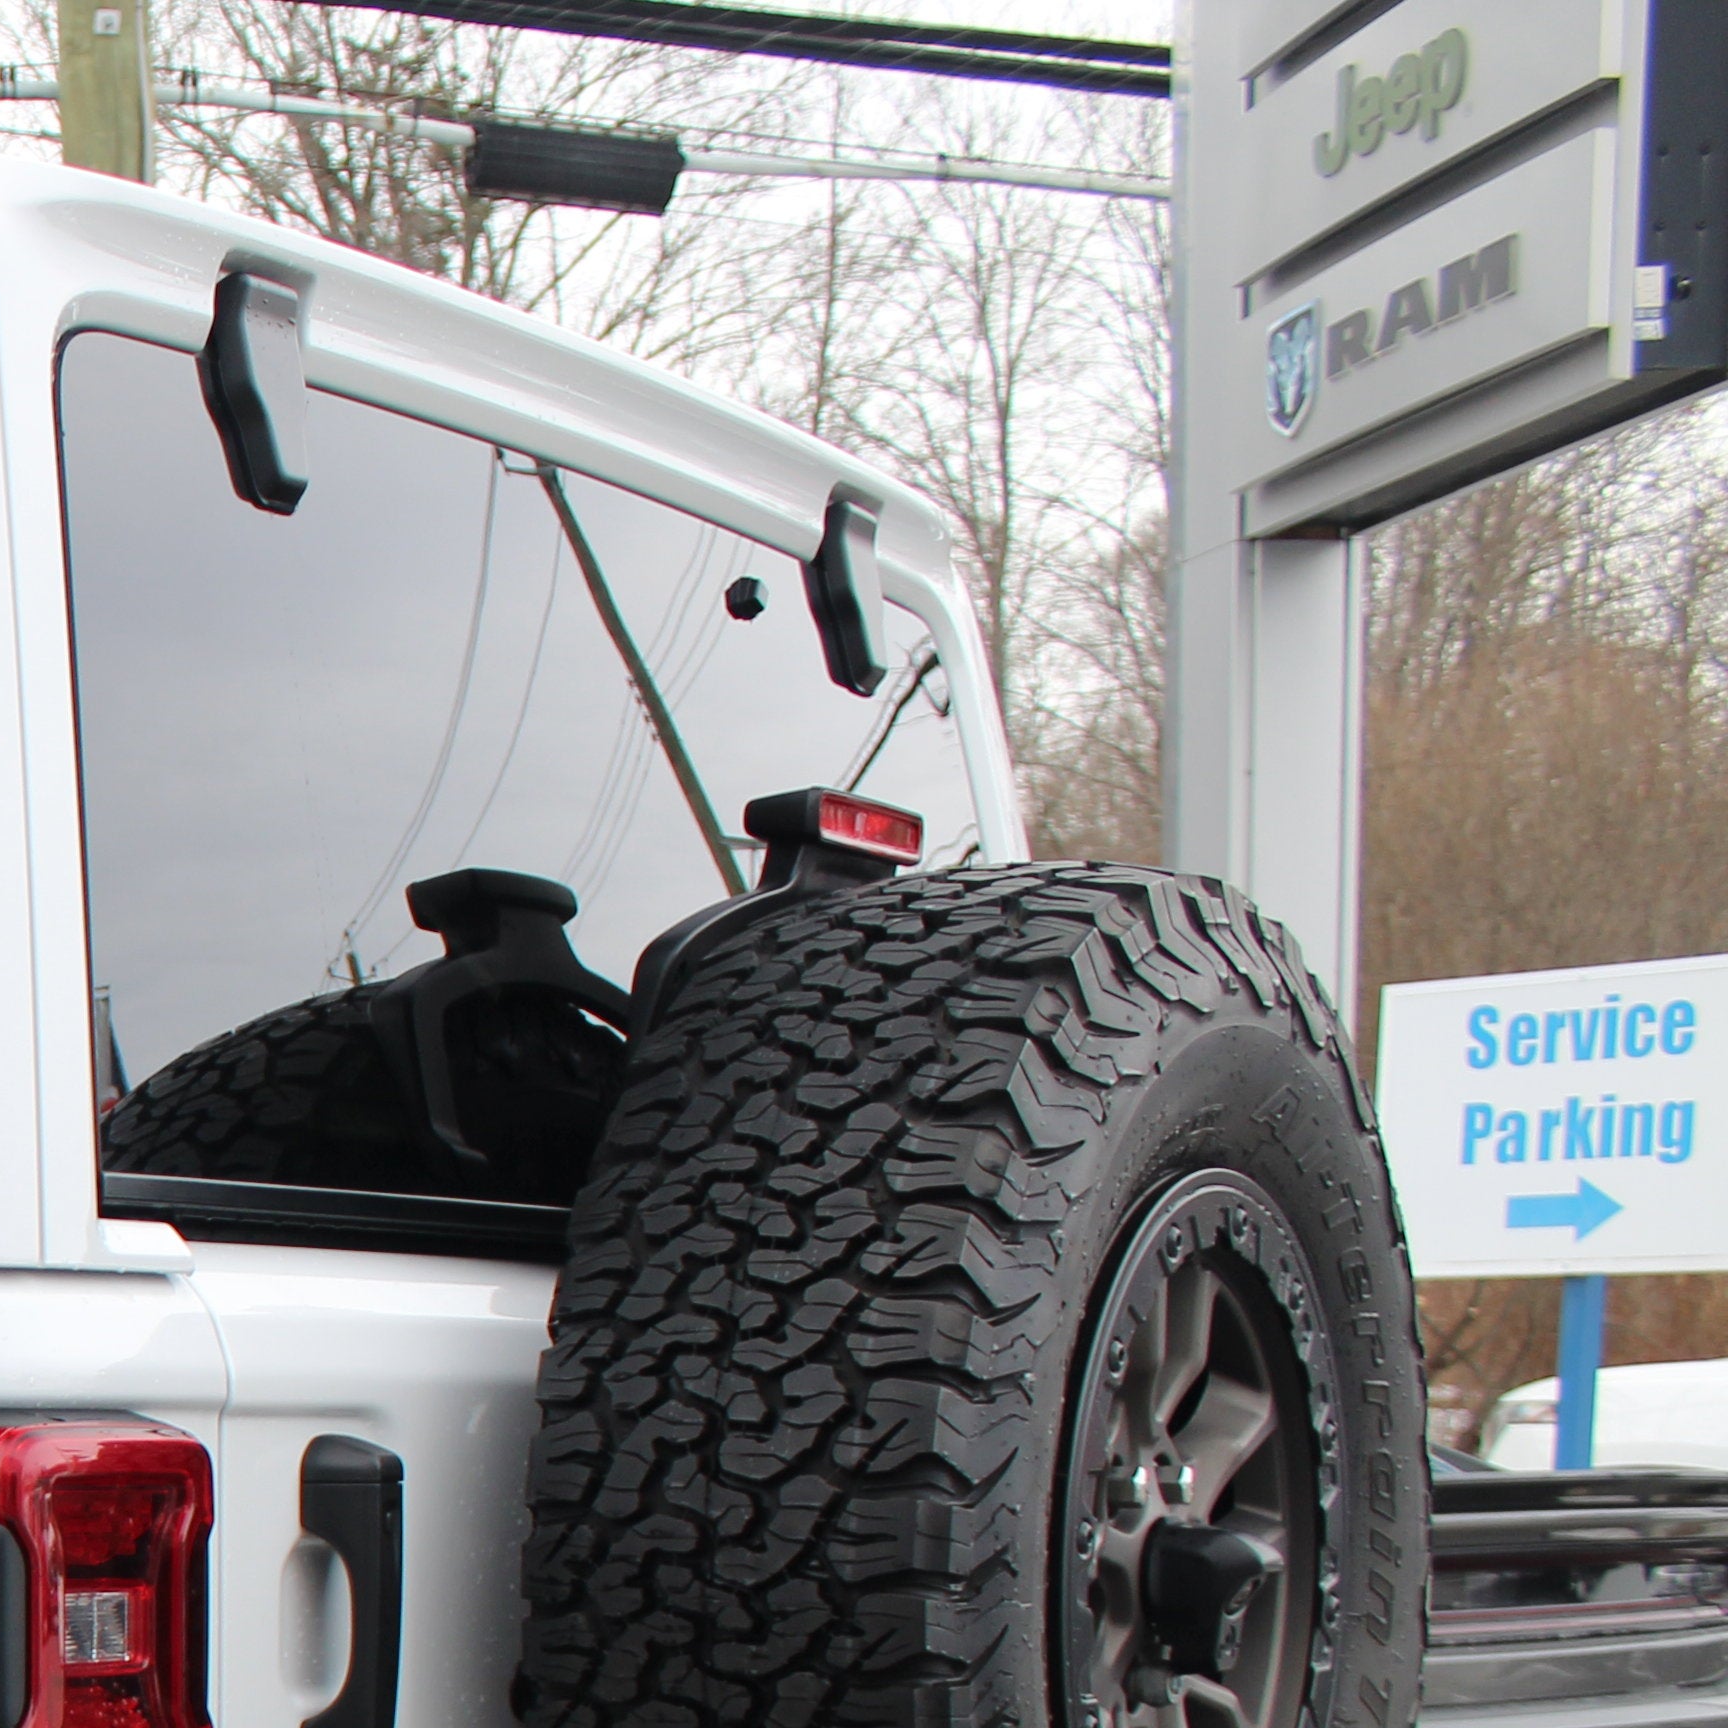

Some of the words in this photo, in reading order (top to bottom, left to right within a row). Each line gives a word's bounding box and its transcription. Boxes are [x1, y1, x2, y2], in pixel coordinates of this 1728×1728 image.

[1314, 27, 1468, 177] Jeep
[1326, 232, 1518, 380] RAM
[1466, 994, 1697, 1069] Service
[1461, 1094, 1695, 1164] Parking
